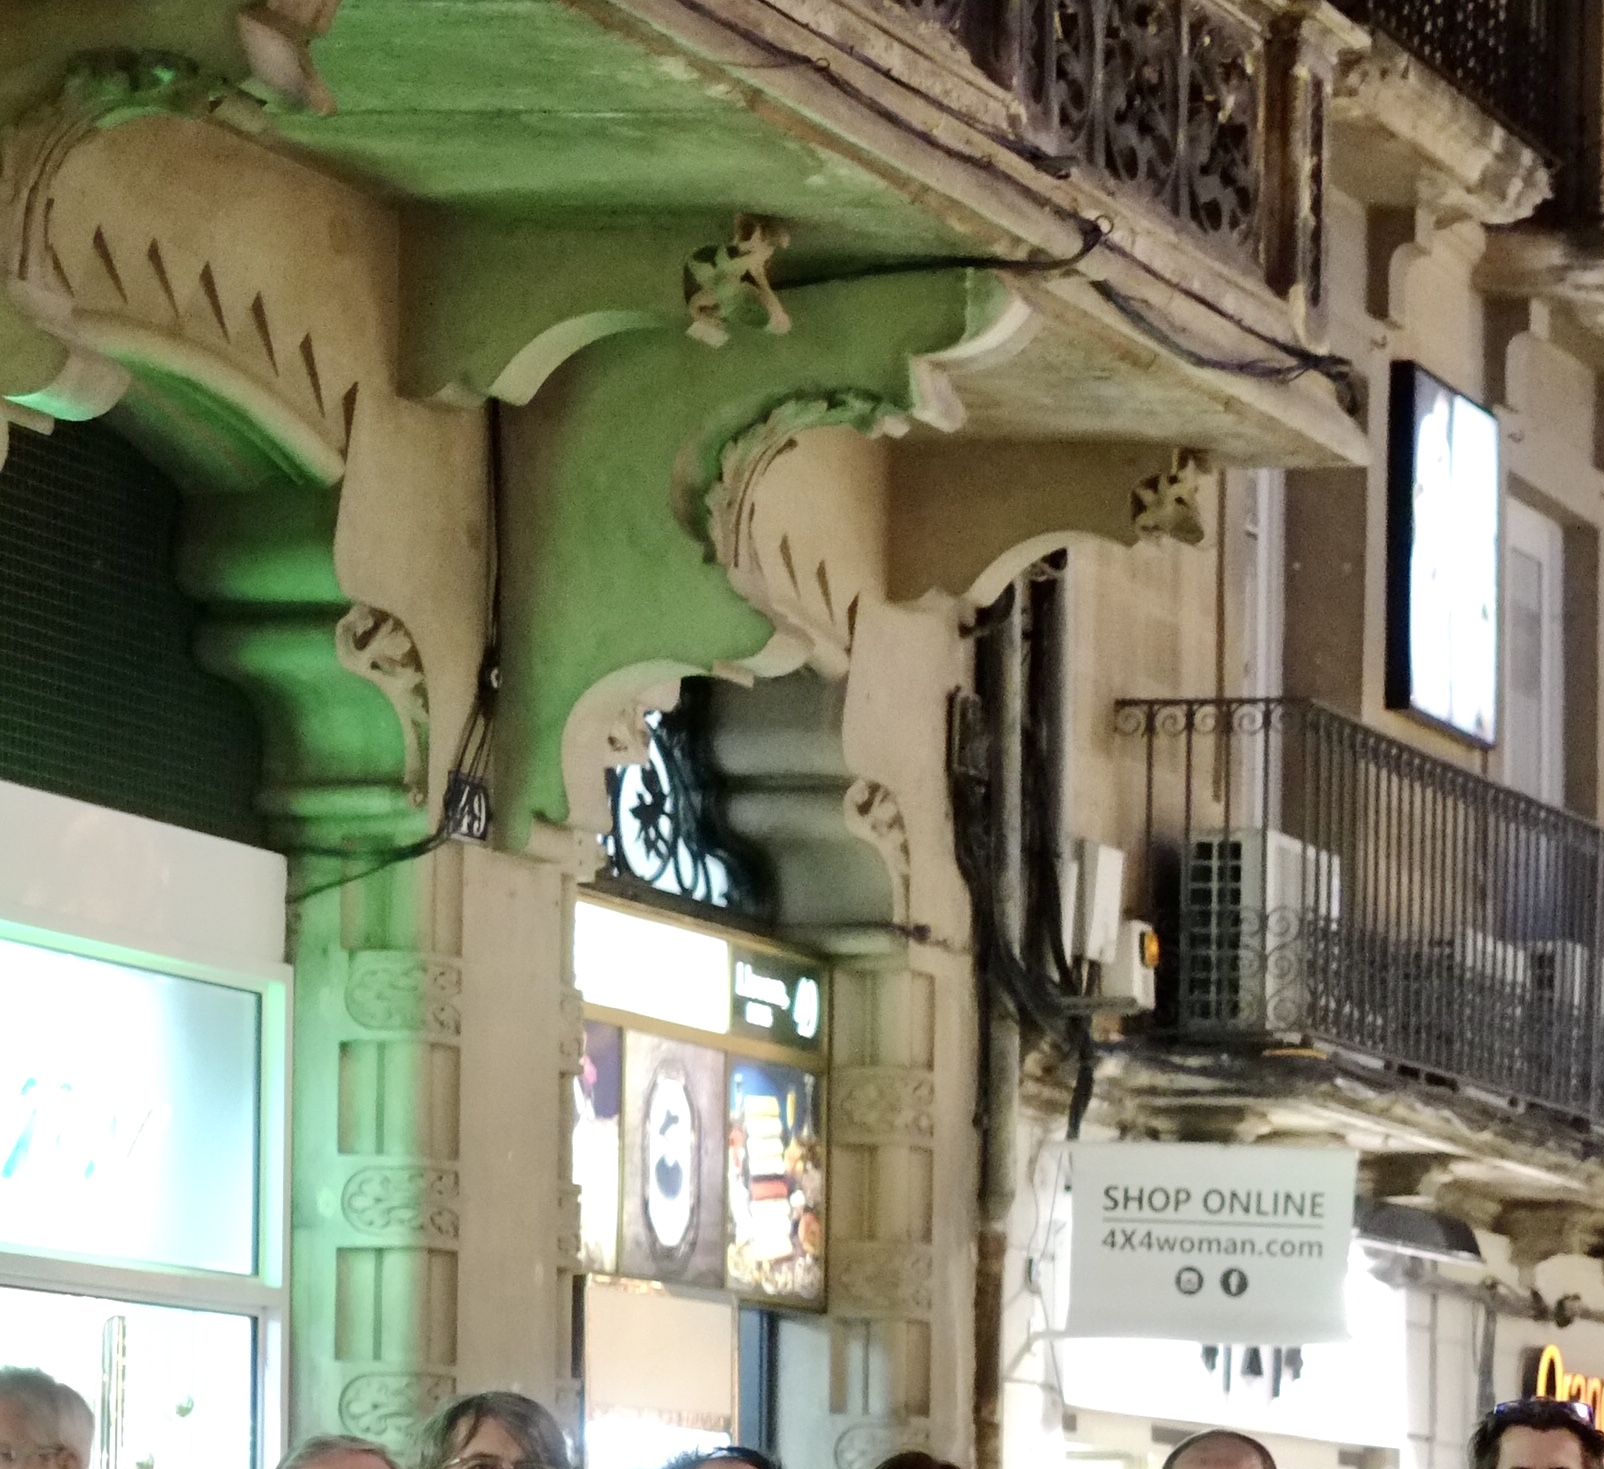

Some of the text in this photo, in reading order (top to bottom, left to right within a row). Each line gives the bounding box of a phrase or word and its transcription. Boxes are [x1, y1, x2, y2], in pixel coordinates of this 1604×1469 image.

[1103, 1185, 1325, 1218] SHOP ONLINE
[1102, 1228, 1324, 1257] 4X4woman.com
